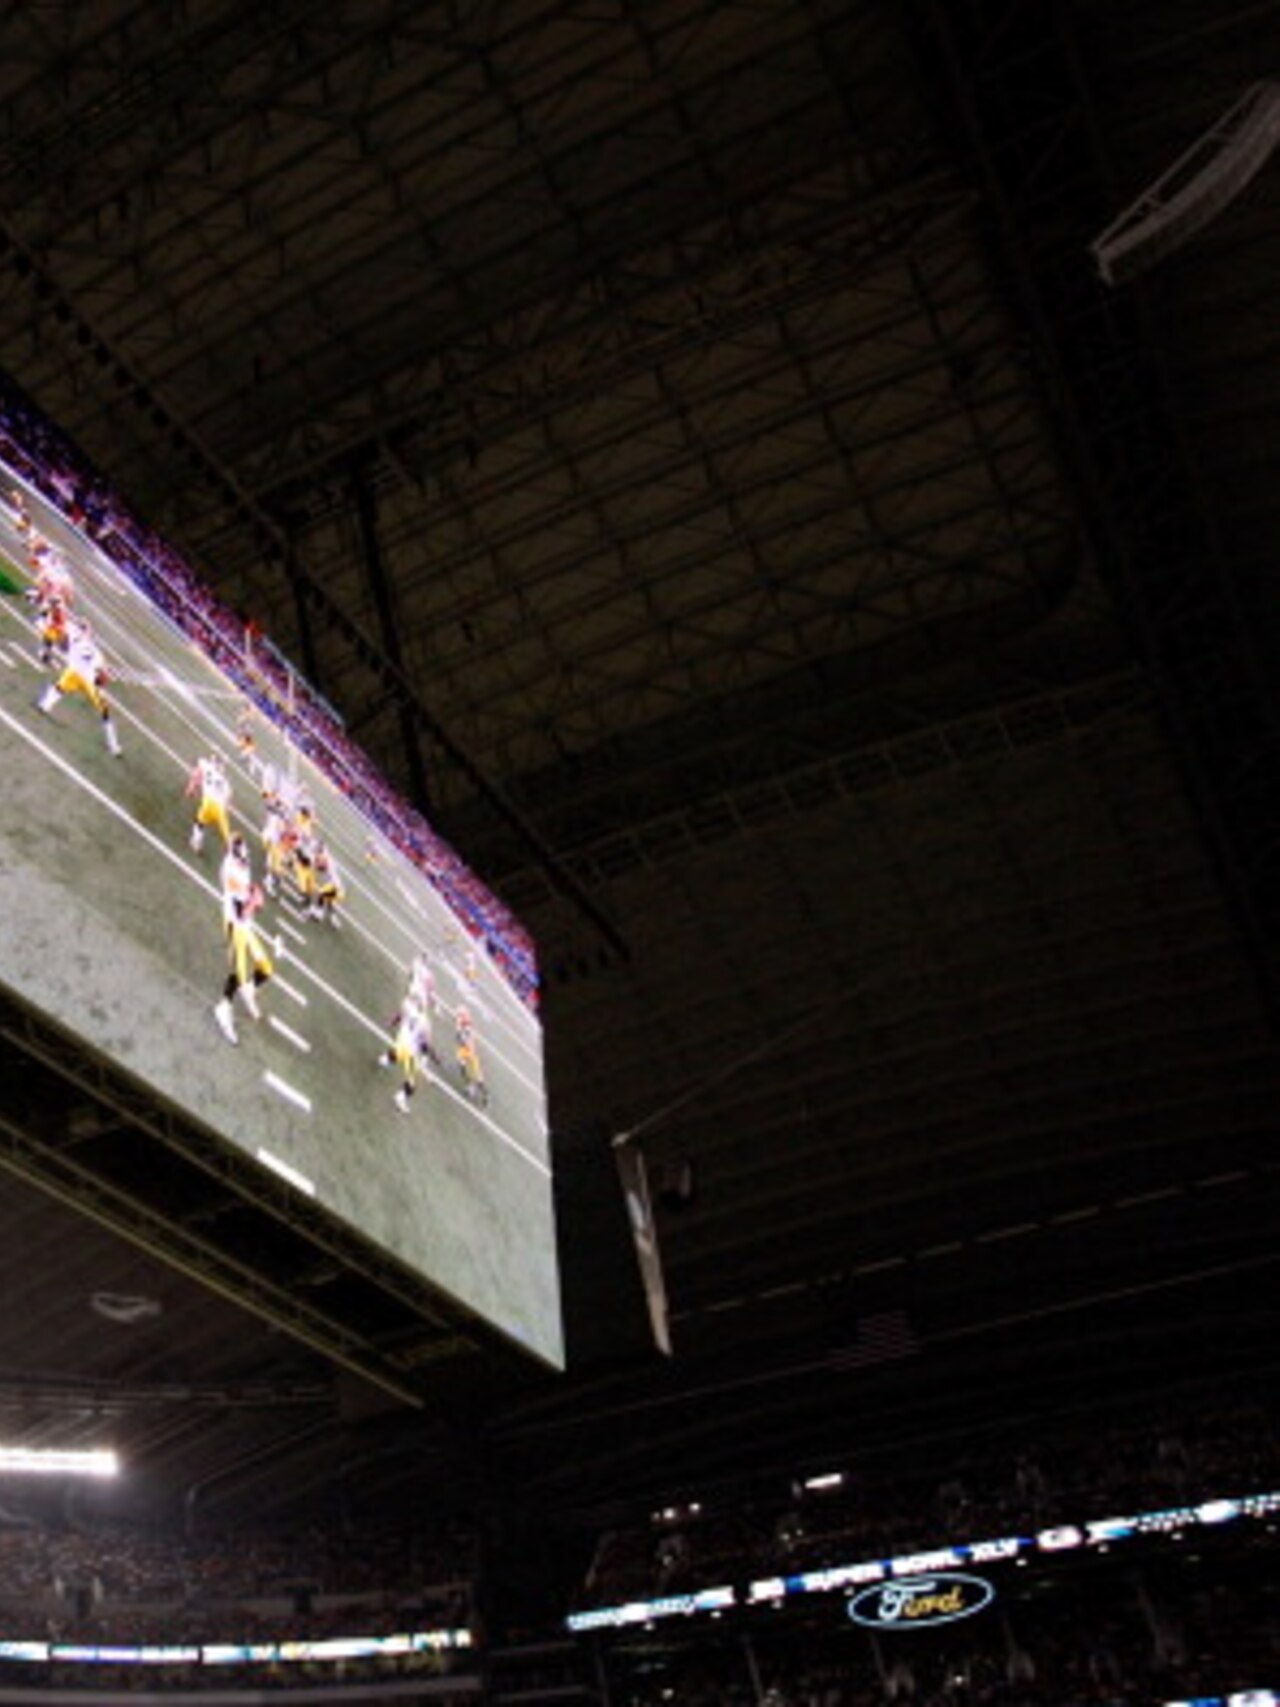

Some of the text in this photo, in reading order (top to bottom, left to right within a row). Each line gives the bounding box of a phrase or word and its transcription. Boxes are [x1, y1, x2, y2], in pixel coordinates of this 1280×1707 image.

[802, 1563, 883, 1590] SUPER
[891, 1550, 962, 1574] BOWL
[973, 1539, 1018, 1560] XLV
[877, 1580, 963, 1622] Ford
